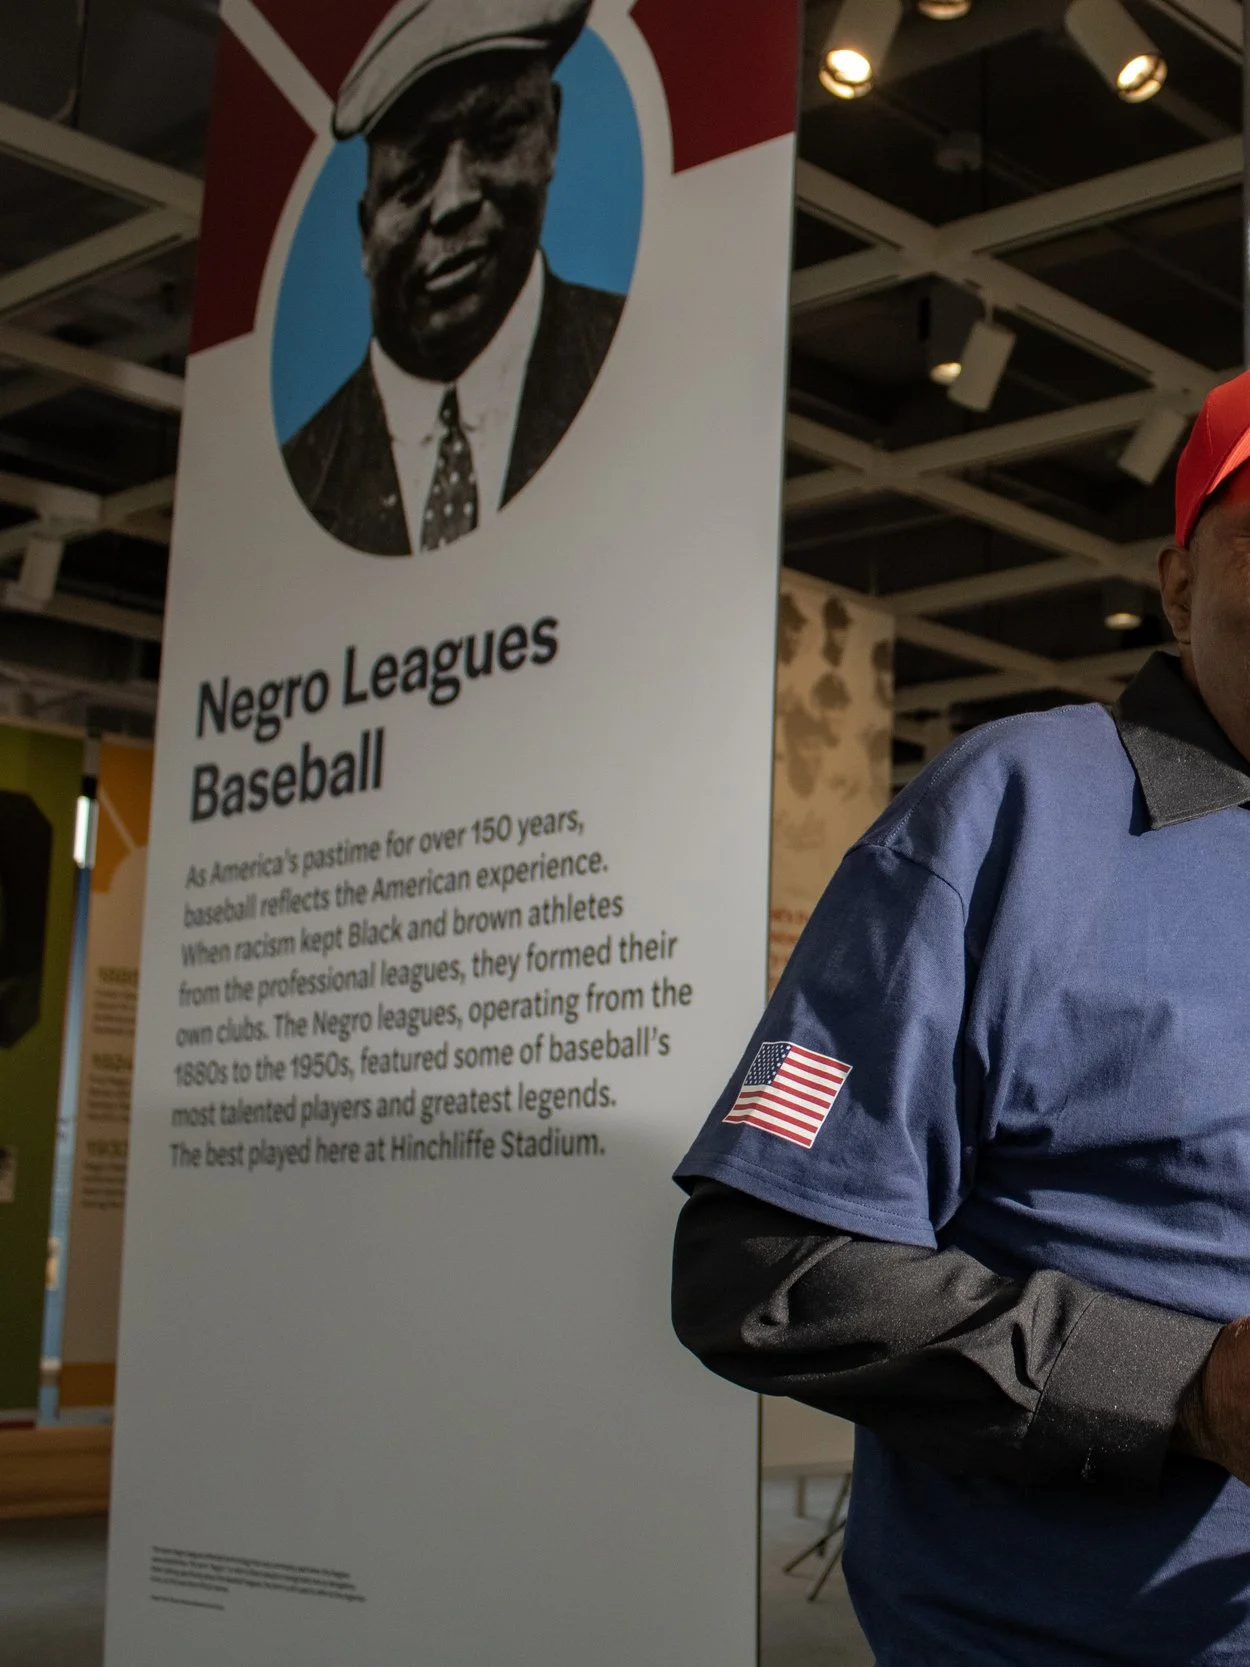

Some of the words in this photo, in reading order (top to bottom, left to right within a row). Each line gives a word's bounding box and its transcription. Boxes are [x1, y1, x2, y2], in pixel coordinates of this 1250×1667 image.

[195, 669, 330, 743] Negro
[342, 615, 558, 707] Leagues
[190, 726, 384, 823] Baseball
[185, 864, 207, 888] As
[209, 848, 299, 884] America's
[302, 839, 381, 876] pastime
[385, 829, 414, 858] for
[419, 827, 466, 854] over
[470, 814, 512, 844] 150
[517, 809, 583, 846] years,
[183, 893, 256, 928] baseball
[259, 887, 329, 917] reflects
[334, 880, 368, 907] the
[371, 868, 470, 902] American
[476, 851, 607, 892] experience.
[180, 940, 231, 967] When
[234, 933, 295, 960] racism
[300, 925, 343, 956] kept
[347, 915, 402, 948] Black
[407, 909, 447, 941] and
[452, 907, 521, 935] brown
[528, 893, 623, 927] athletes
[178, 979, 220, 1006] from
[223, 976, 254, 1003] the
[257, 961, 375, 1003] professional
[380, 959, 465, 990] leagues,
[471, 949, 520, 981] they
[526, 935, 611, 972] formed
[618, 930, 677, 964] their
[175, 1025, 213, 1048] own
[215, 1015, 269, 1044] clubs.
[273, 1011, 308, 1037] The
[312, 1010, 372, 1039] Negro
[377, 1003, 462, 1034] leagues,
[468, 988, 579, 1028] operating
[586, 982, 643, 1012] from
[651, 977, 692, 1008] the
[173, 1059, 228, 1087] 1880s
[231, 1060, 251, 1083] to
[255, 1054, 286, 1082] the
[290, 1050, 354, 1079] 1950s,
[360, 1041, 448, 1074] featured
[453, 1044, 513, 1069] some
[519, 1032, 543, 1064] of
[549, 1025, 669, 1062] baseball's
[171, 1103, 216, 1127] most
[219, 1094, 296, 1126] talented
[300, 1093, 371, 1126] players
[375, 1087, 416, 1118] and
[419, 1086, 511, 1121] greatest
[518, 1077, 615, 1117] legends.
[169, 1141, 202, 1167] The
[205, 1141, 244, 1167] best
[247, 1136, 311, 1169] played
[315, 1135, 360, 1163] here
[364, 1137, 385, 1162] at
[390, 1128, 495, 1160] Hinchliffe
[501, 1126, 604, 1158] Stadium.
